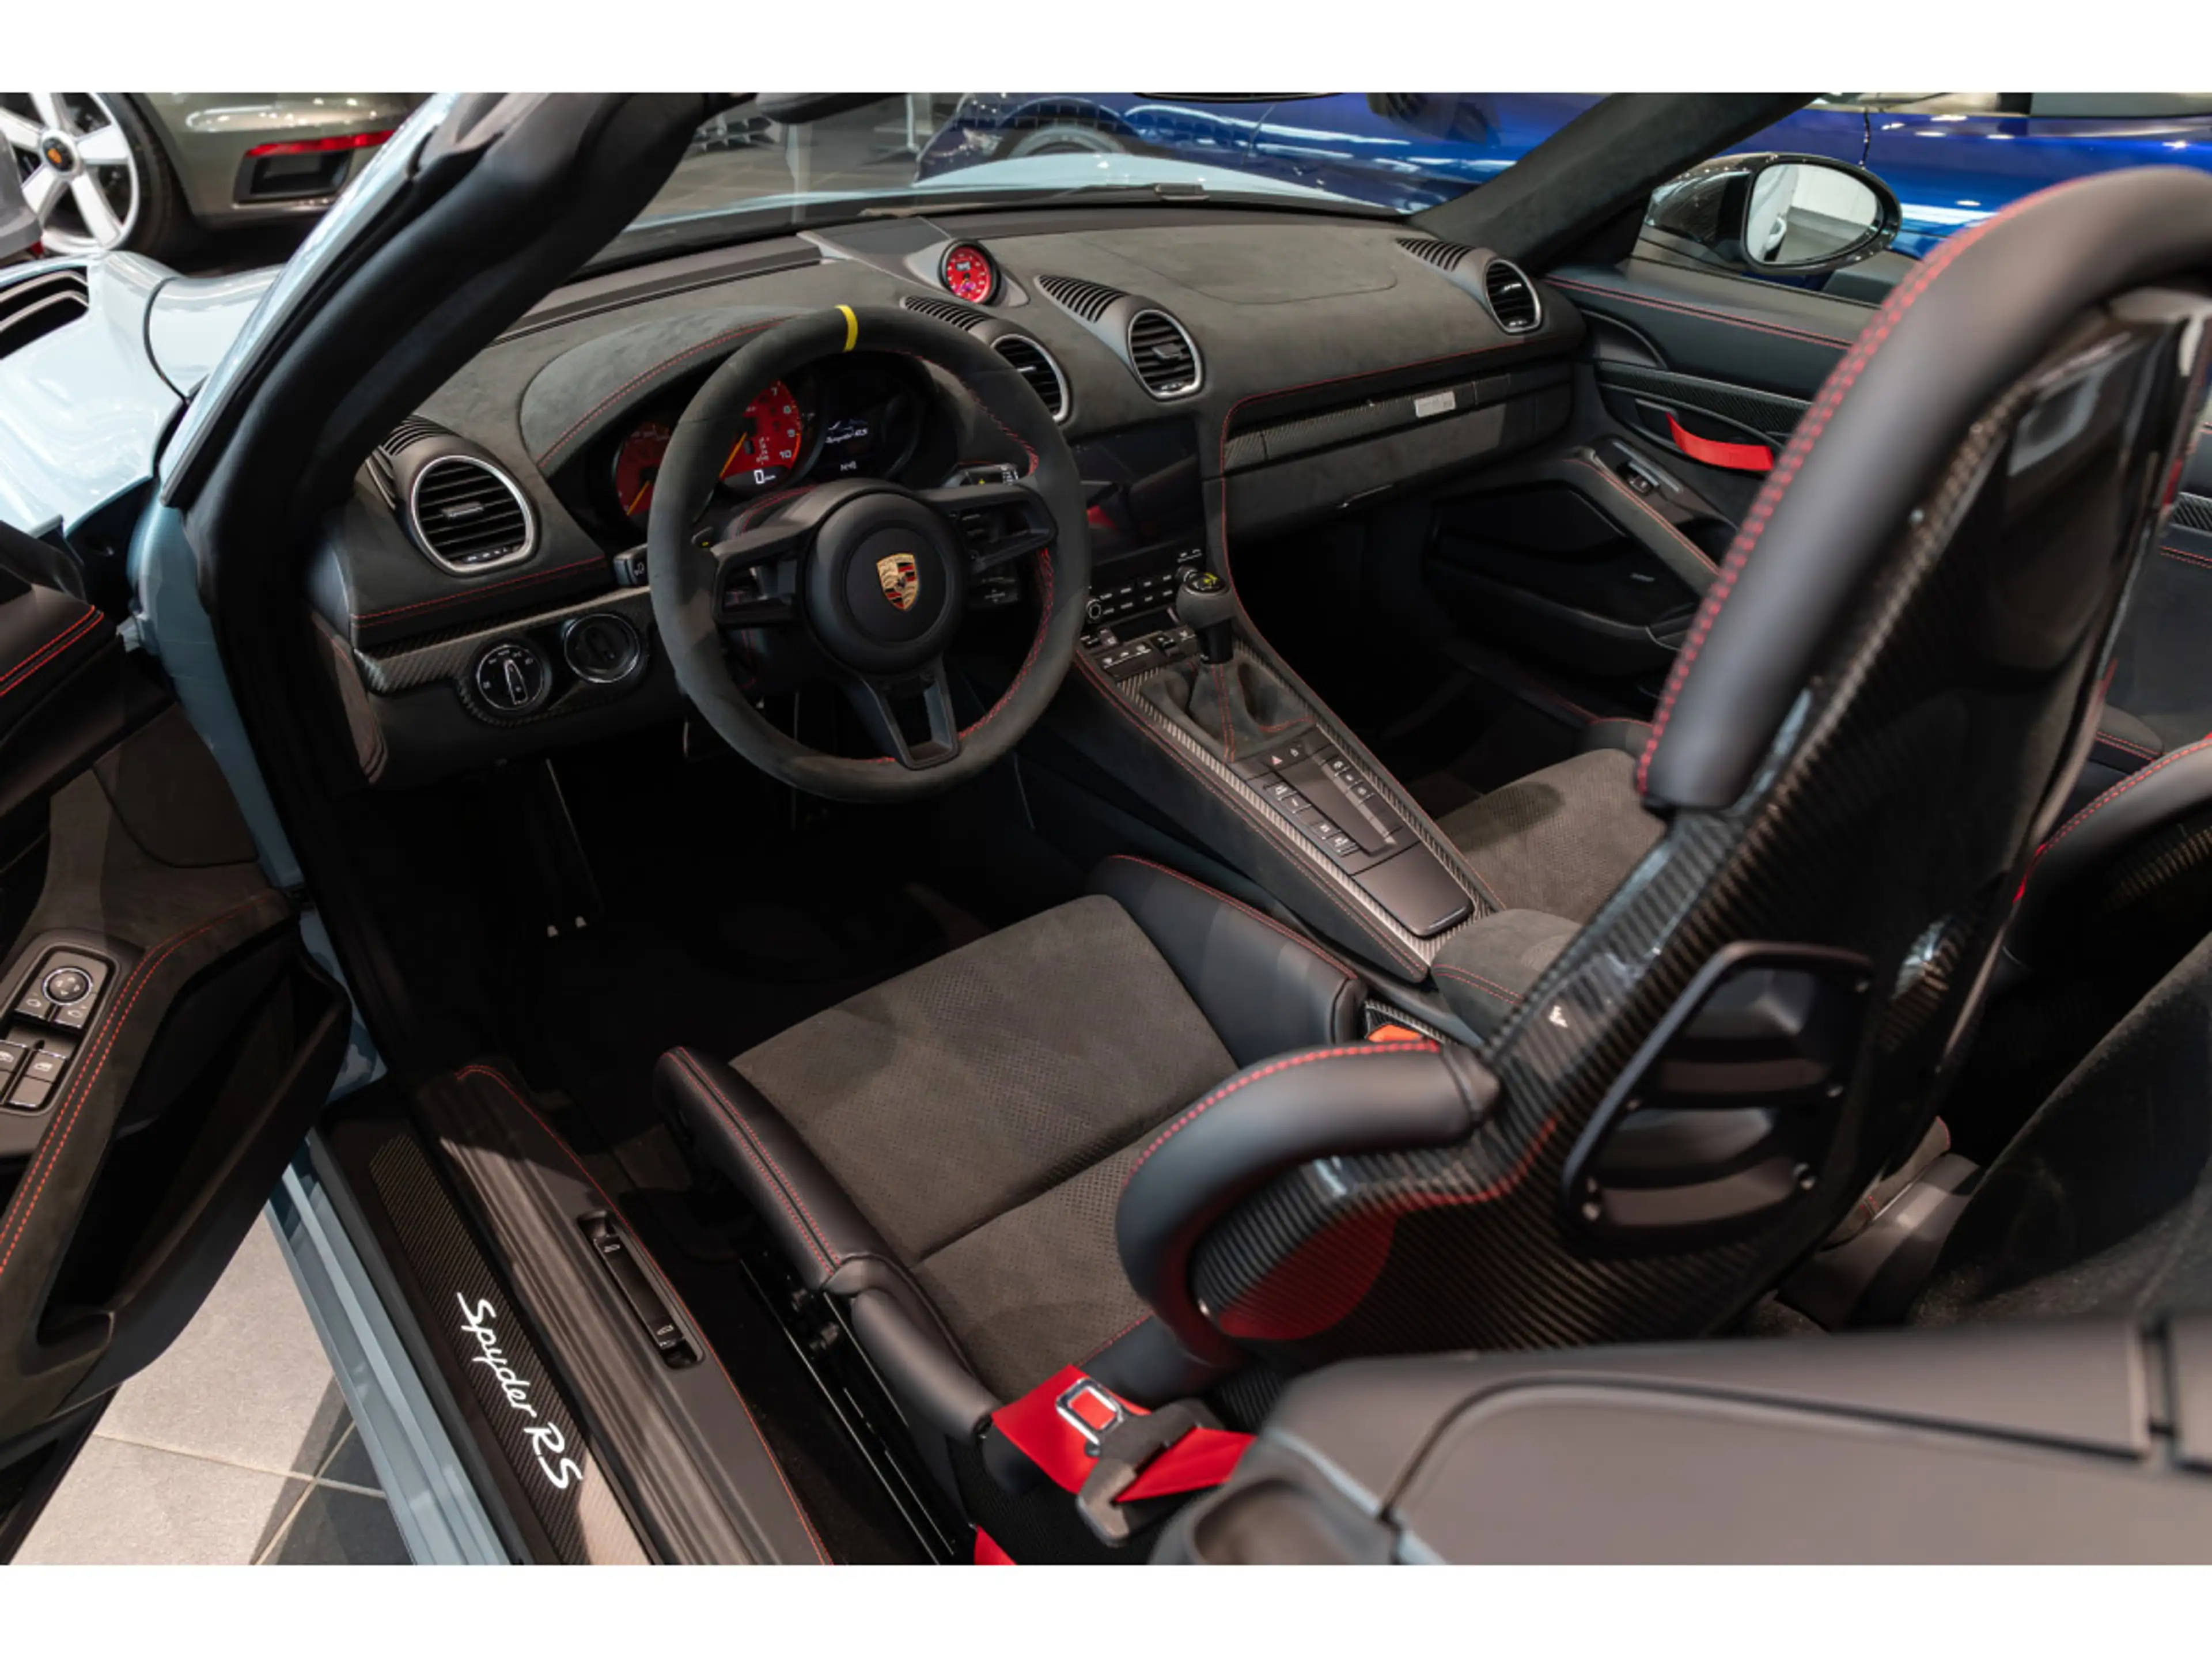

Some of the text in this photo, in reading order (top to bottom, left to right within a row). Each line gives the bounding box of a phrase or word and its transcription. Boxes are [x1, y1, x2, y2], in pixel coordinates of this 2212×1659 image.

[779, 449, 792, 459] 10
[753, 468, 765, 484] 0
[457, 1292, 584, 1489] Spyder RS
